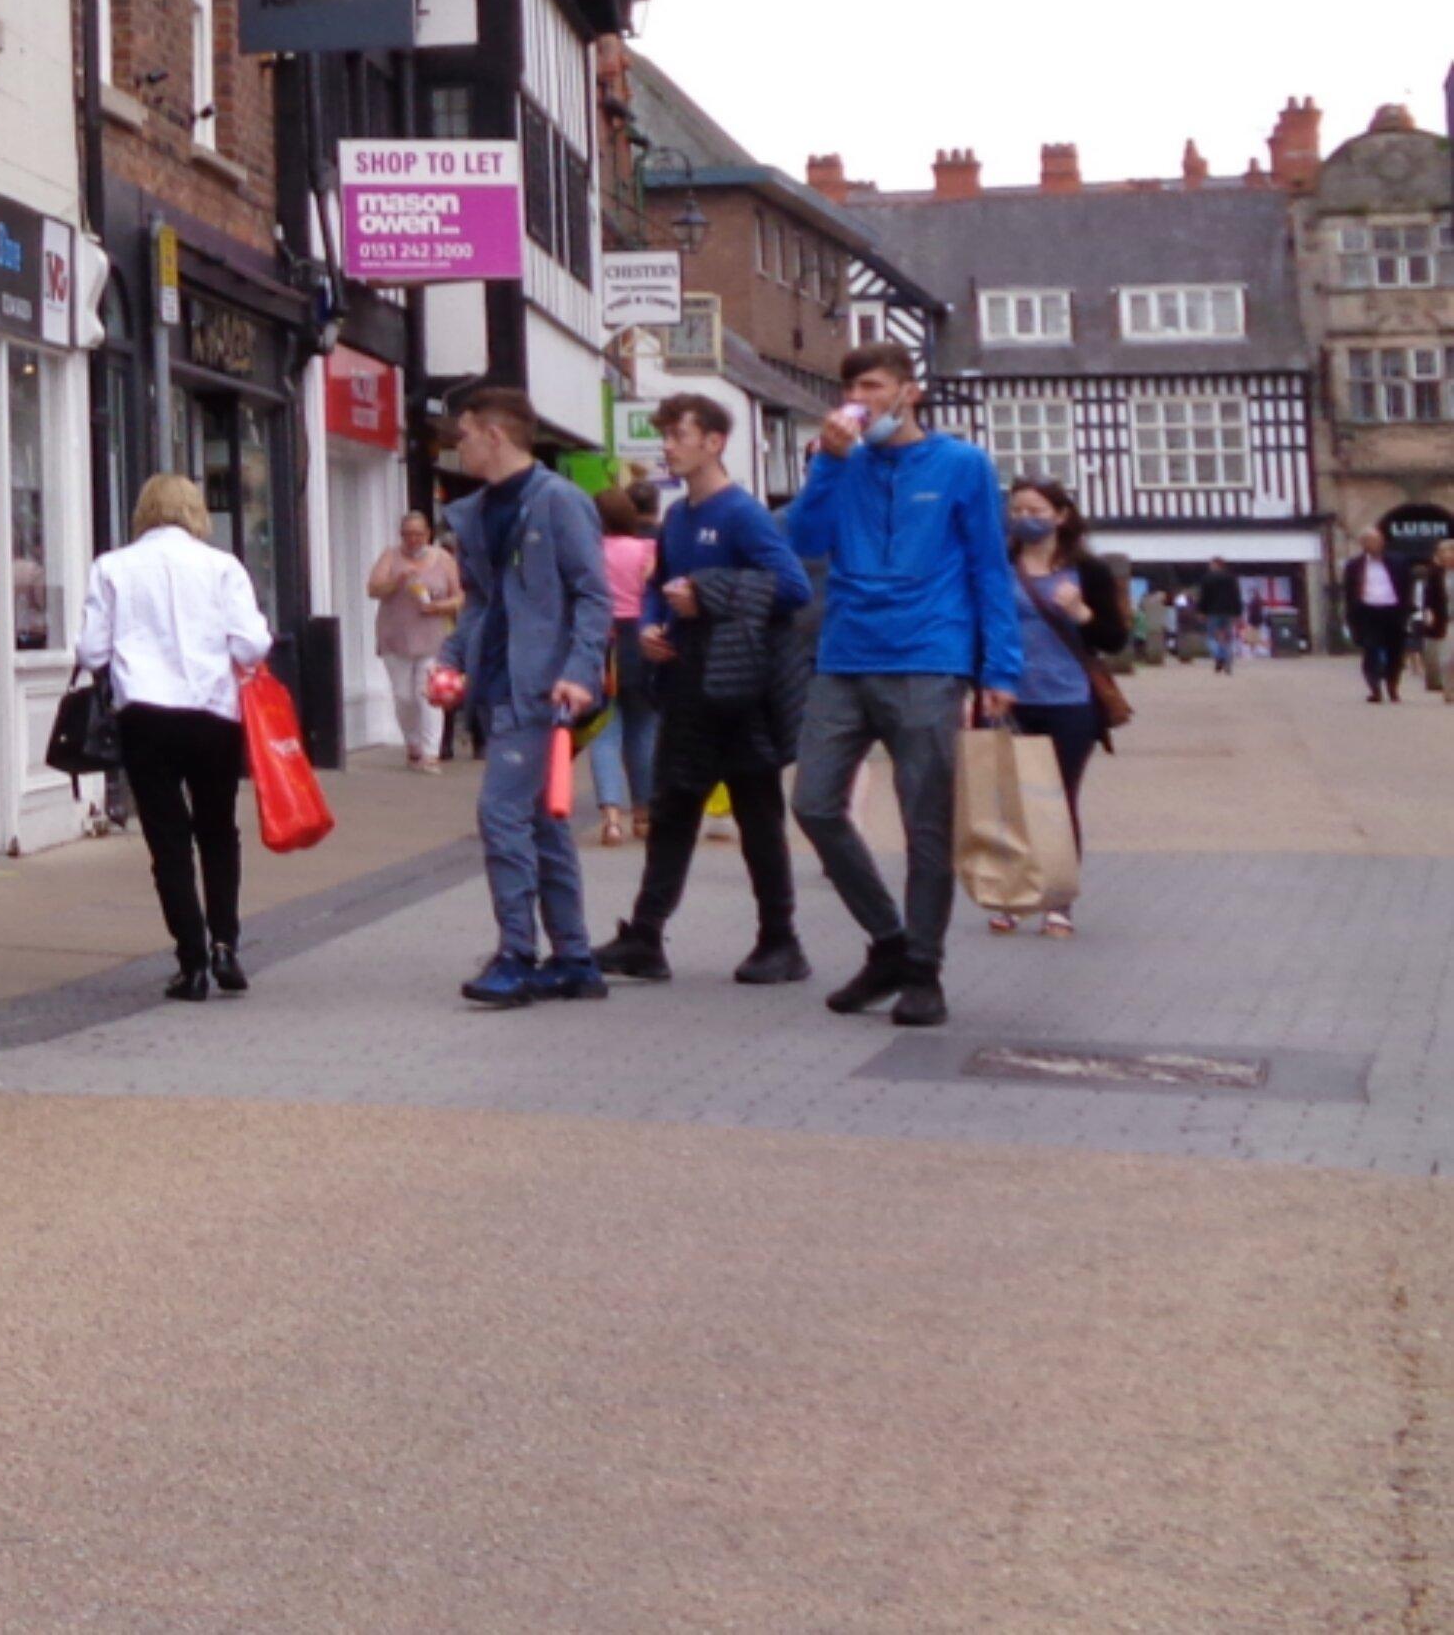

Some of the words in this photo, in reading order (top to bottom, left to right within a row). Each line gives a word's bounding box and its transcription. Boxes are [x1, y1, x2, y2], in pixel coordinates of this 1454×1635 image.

[355, 151, 418, 175] SHOP
[425, 151, 456, 175] TO
[464, 151, 503, 175] LET
[356, 192, 461, 214] mason
[358, 213, 441, 235] owen
[359, 242, 396, 258] 0151
[400, 242, 430, 258] 242
[1392, 519, 1447, 537] LUSH
